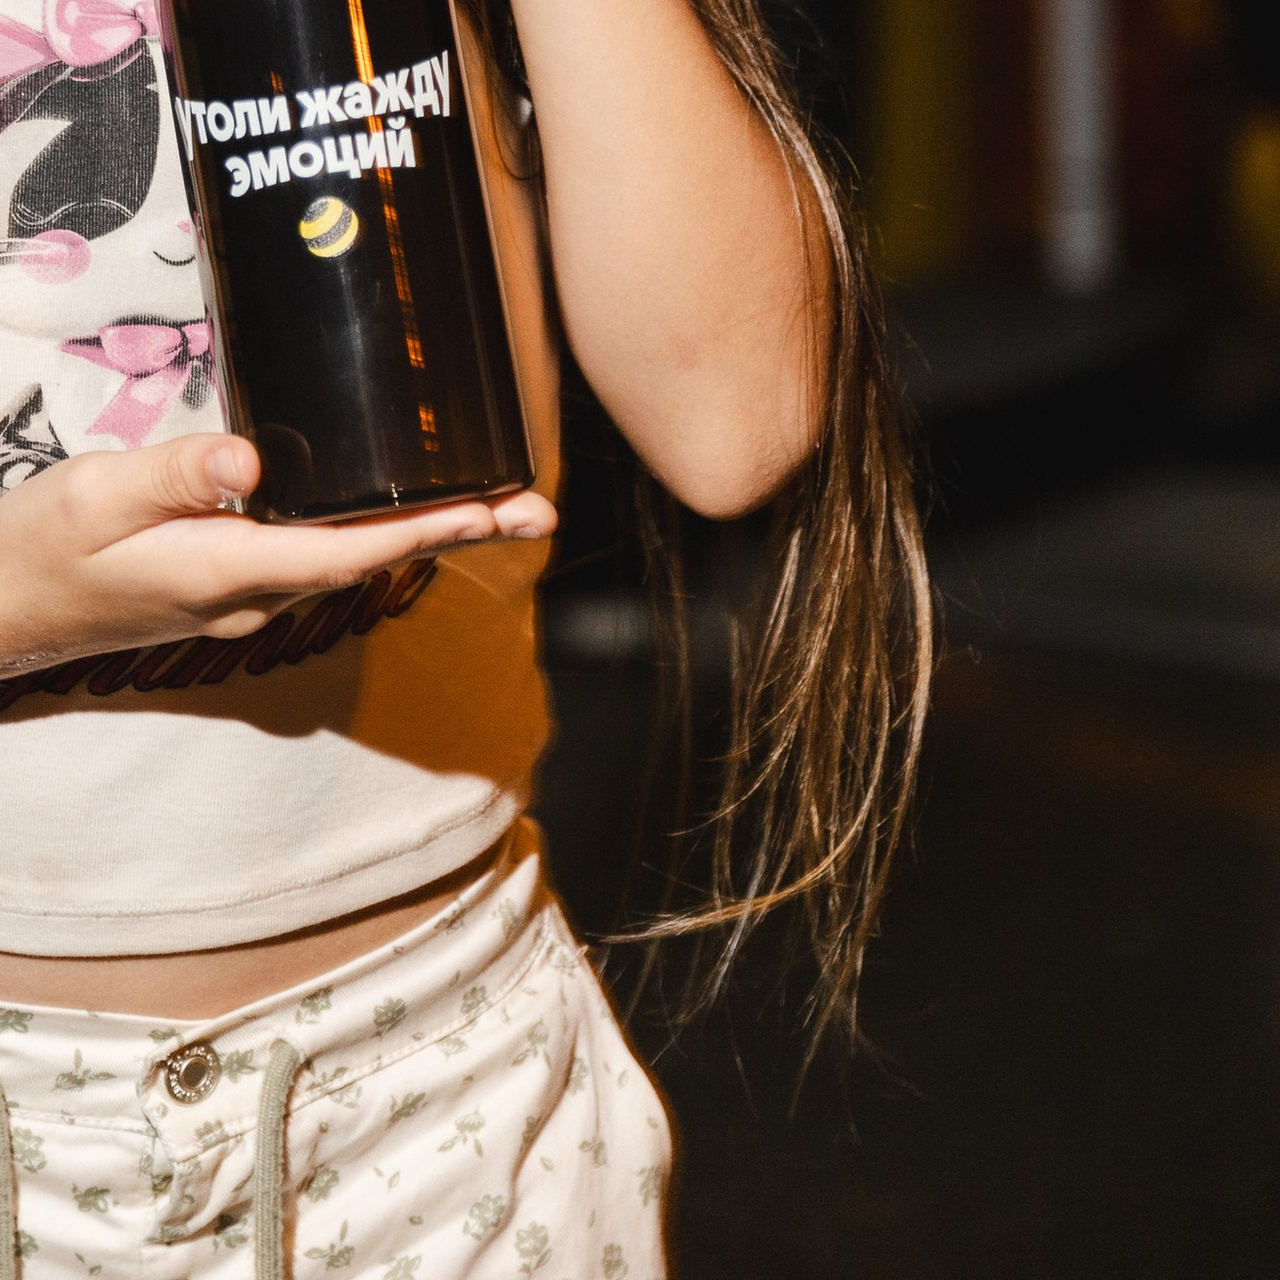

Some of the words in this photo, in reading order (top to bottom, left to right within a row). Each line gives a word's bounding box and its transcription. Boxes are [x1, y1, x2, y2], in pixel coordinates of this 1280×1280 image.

[175, 96, 291, 161] утоли
[296, 50, 450, 128] жажду
[225, 116, 416, 197] эмоций
